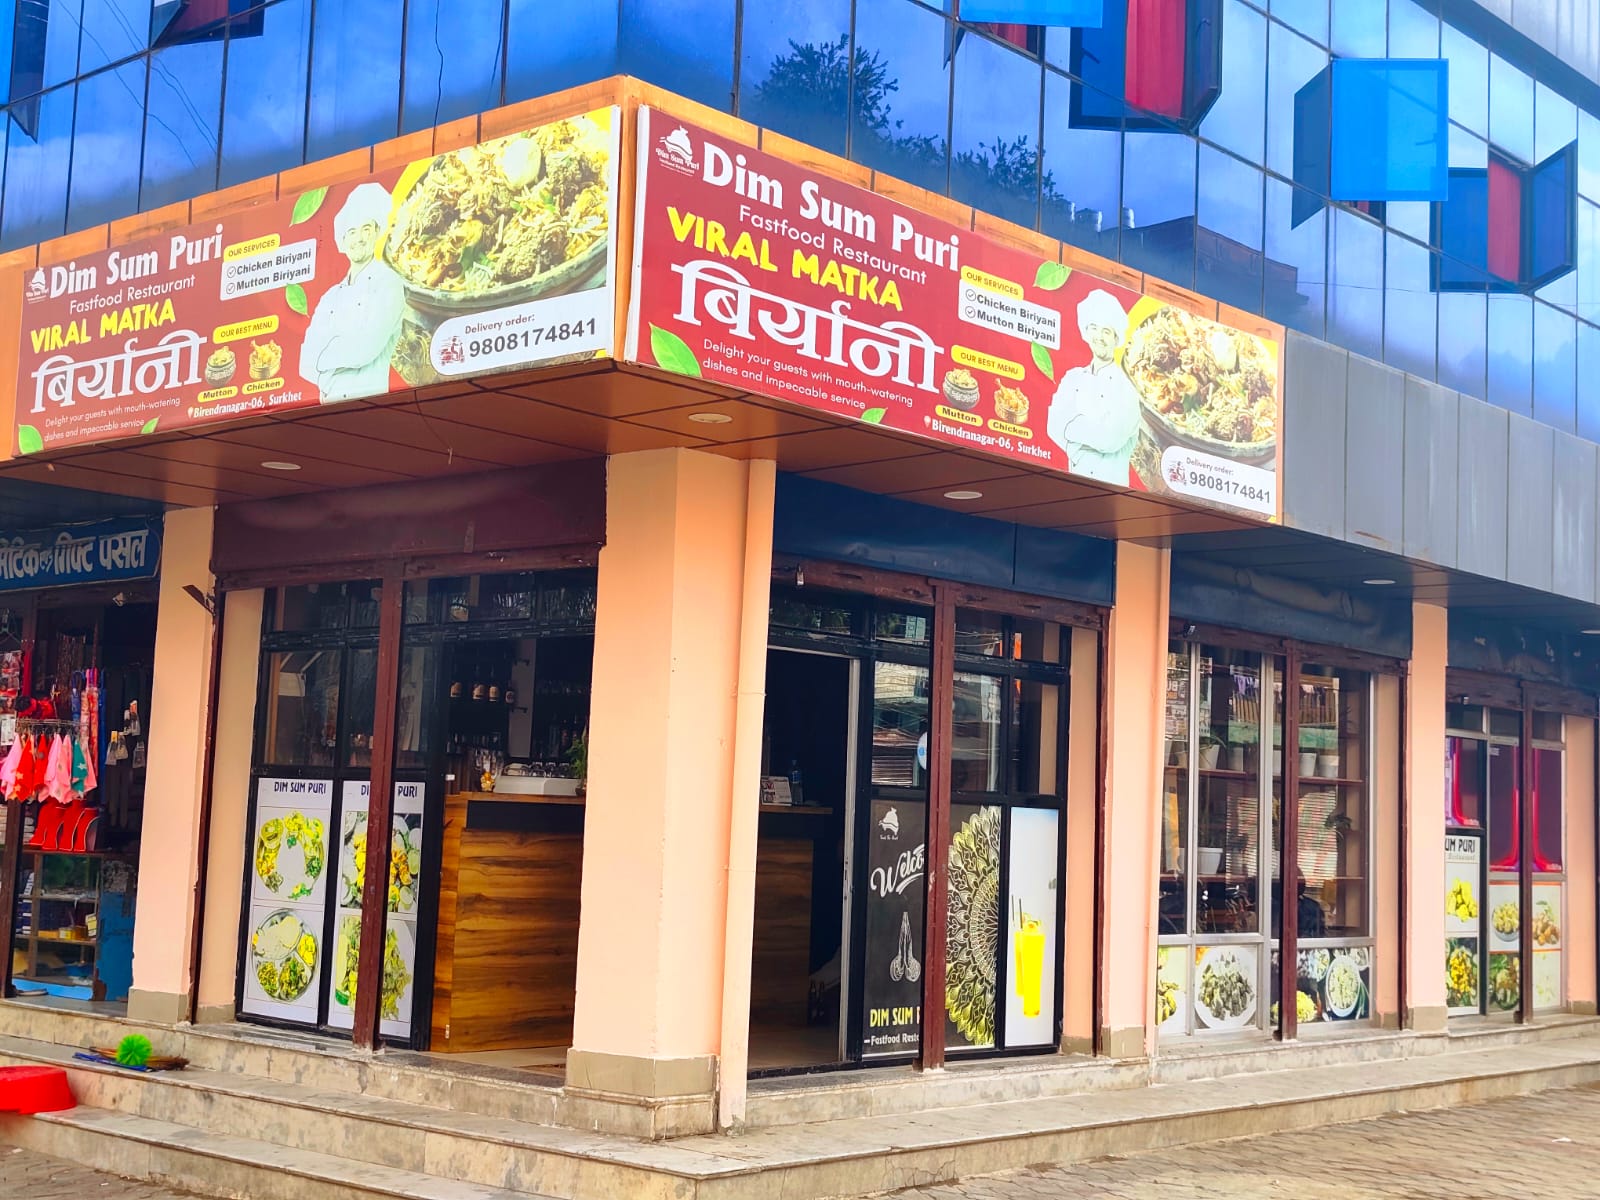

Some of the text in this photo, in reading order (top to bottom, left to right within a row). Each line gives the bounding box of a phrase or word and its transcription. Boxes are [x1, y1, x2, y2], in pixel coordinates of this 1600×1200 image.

[702, 141, 959, 272] Dim Sum Puri
[229, 239, 276, 257] OUR SERVICES
[666, 206, 903, 311] VIRAL MATKA
[739, 204, 927, 285] Fastfood Restaurant
[50, 261, 96, 298] Dim
[107, 250, 158, 284] Sum
[170, 223, 223, 269] Puri
[236, 249, 312, 276] Chicken Biriyani
[236, 264, 310, 291] Mutton Biriyani
[966, 271, 1019, 296] OUR SERVICES
[70, 291, 122, 314] Fastfood
[127, 274, 196, 301] Restaurant
[30, 298, 176, 353] VIRAL MATKA
[465, 313, 535, 334] Delivery order:
[977, 293, 1056, 328] Chicken Biriyani
[220, 320, 273, 338] OUR BEST MENU
[469, 318, 596, 358] 9808174841
[671, 259, 944, 394] बिर्यानी
[977, 309, 1056, 344] Mutton Biriyani
[30, 329, 207, 413] बिर्यानी
[703, 339, 913, 408] Delight your guests with mouth-watering
[960, 351, 1019, 375] OUR BEST MENU
[203, 379, 281, 400] Mutton Chicken
[702, 358, 865, 409] dishes and impeccable service
[45, 397, 180, 427] Delight your guests with mouth-watering
[193, 390, 302, 418] Birendranagar-06, Surkhet
[44, 418, 145, 442] dishes and impeccable service
[942, 407, 1029, 437] Mutton Chicken
[932, 418, 1051, 460] Birendranagar-06, Surkhet
[1186, 457, 1234, 476] Delivery order:
[1189, 471, 1270, 503] 9808174841
[99, 528, 149, 571] पसल
[274, 781, 327, 794] DIM SUM PURI
[397, 785, 418, 798] PURI
[1458, 838, 1476, 853] PURI
[870, 1008, 889, 1027] DIM
[892, 1006, 913, 1026] SUM
[871, 1034, 900, 1046] Fastfood
